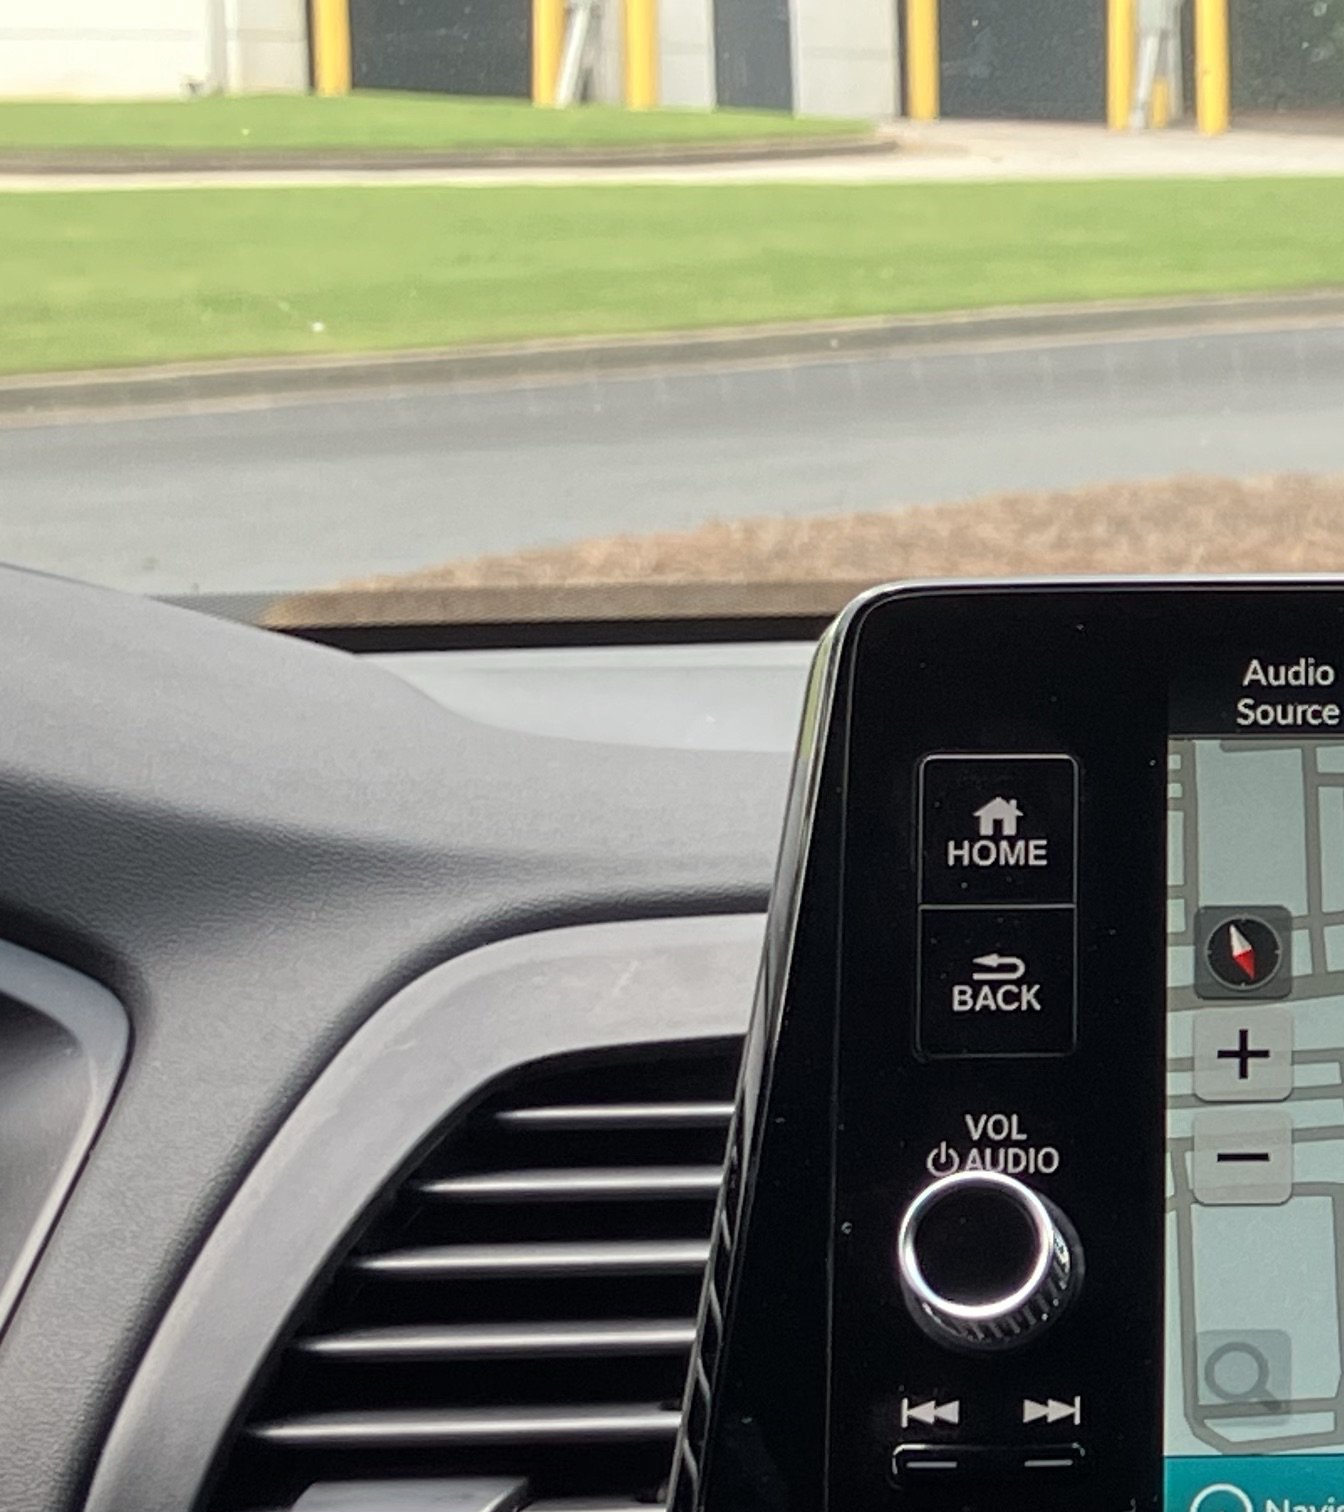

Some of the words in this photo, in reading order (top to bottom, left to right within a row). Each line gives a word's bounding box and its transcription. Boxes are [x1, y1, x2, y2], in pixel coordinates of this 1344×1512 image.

[1242, 657, 1335, 687] Audio
[1236, 697, 1341, 726] Source
[947, 839, 1048, 867] HOME
[952, 984, 1041, 1012] BACK
[965, 1113, 1028, 1141] VOL
[965, 1147, 1060, 1176] AUDIO
